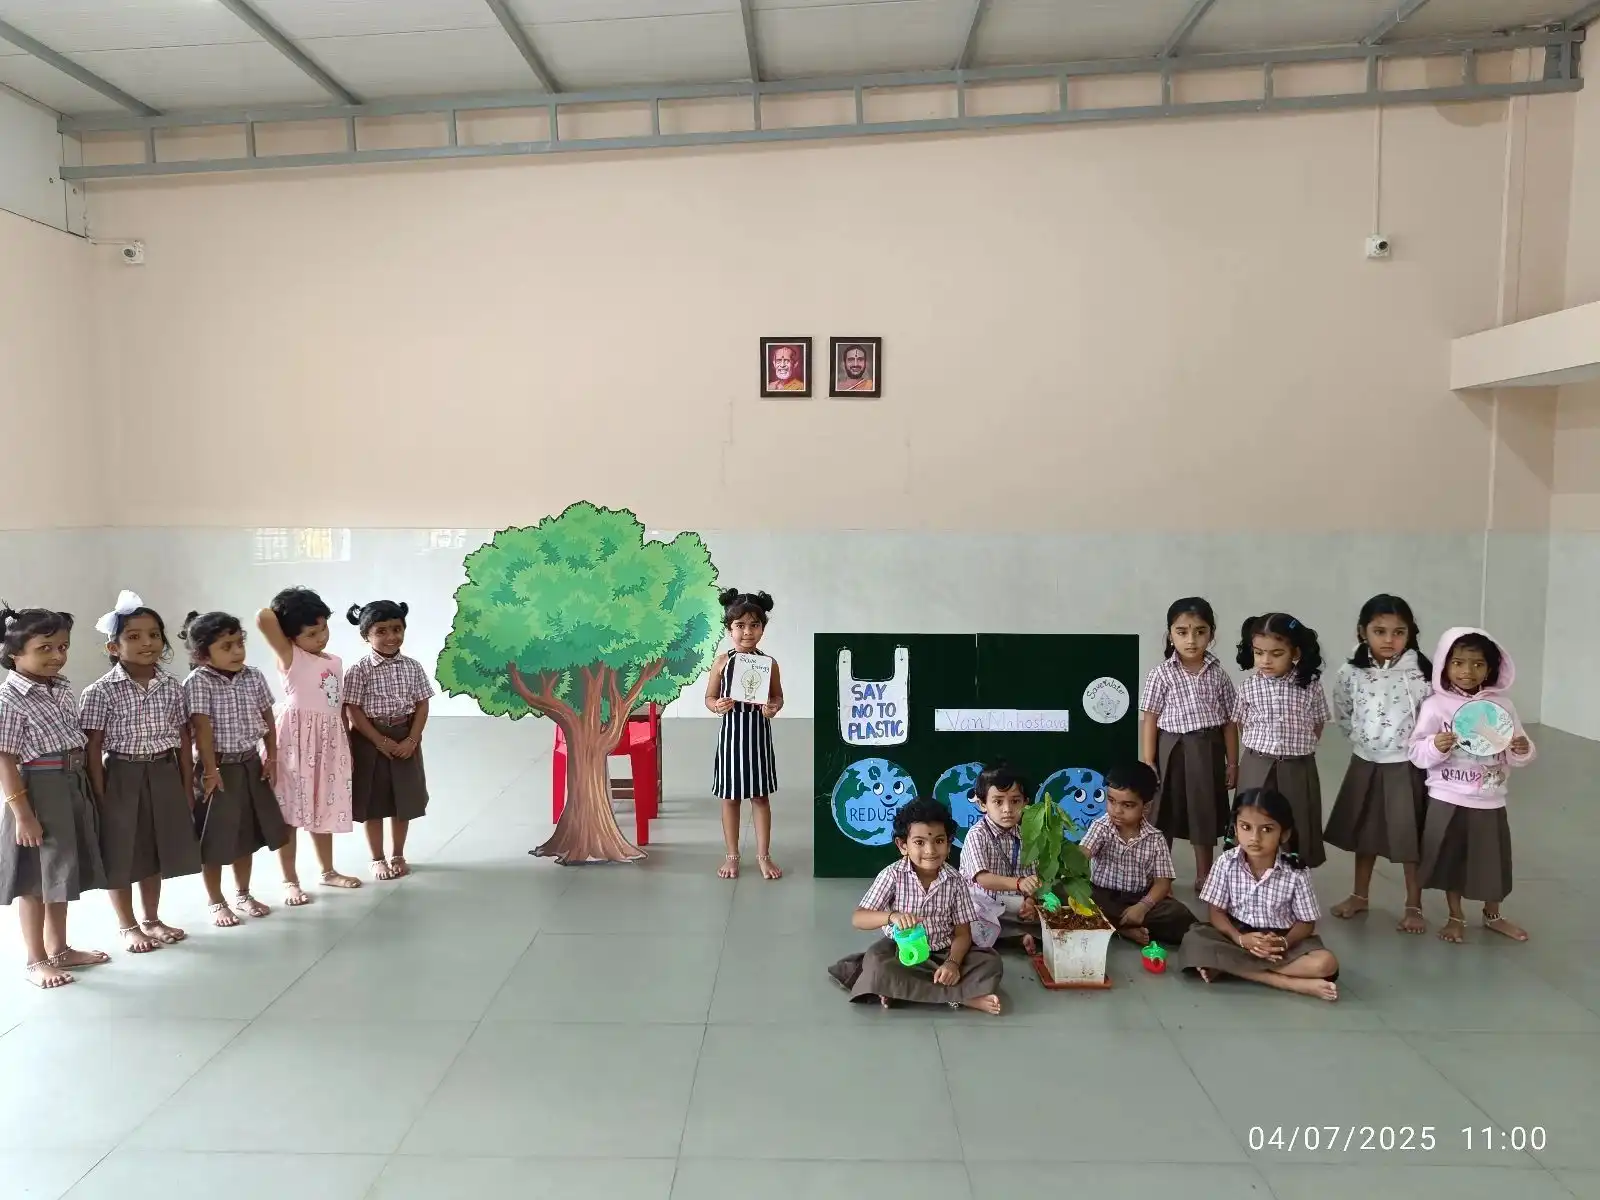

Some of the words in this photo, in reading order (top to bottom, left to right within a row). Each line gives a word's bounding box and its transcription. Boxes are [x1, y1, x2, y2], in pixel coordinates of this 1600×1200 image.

[851, 683, 888, 701] SAY
[851, 703, 874, 719] NO
[876, 702, 897, 719] TO
[848, 719, 905, 741] PLASTIC
[945, 711, 984, 731] Van
